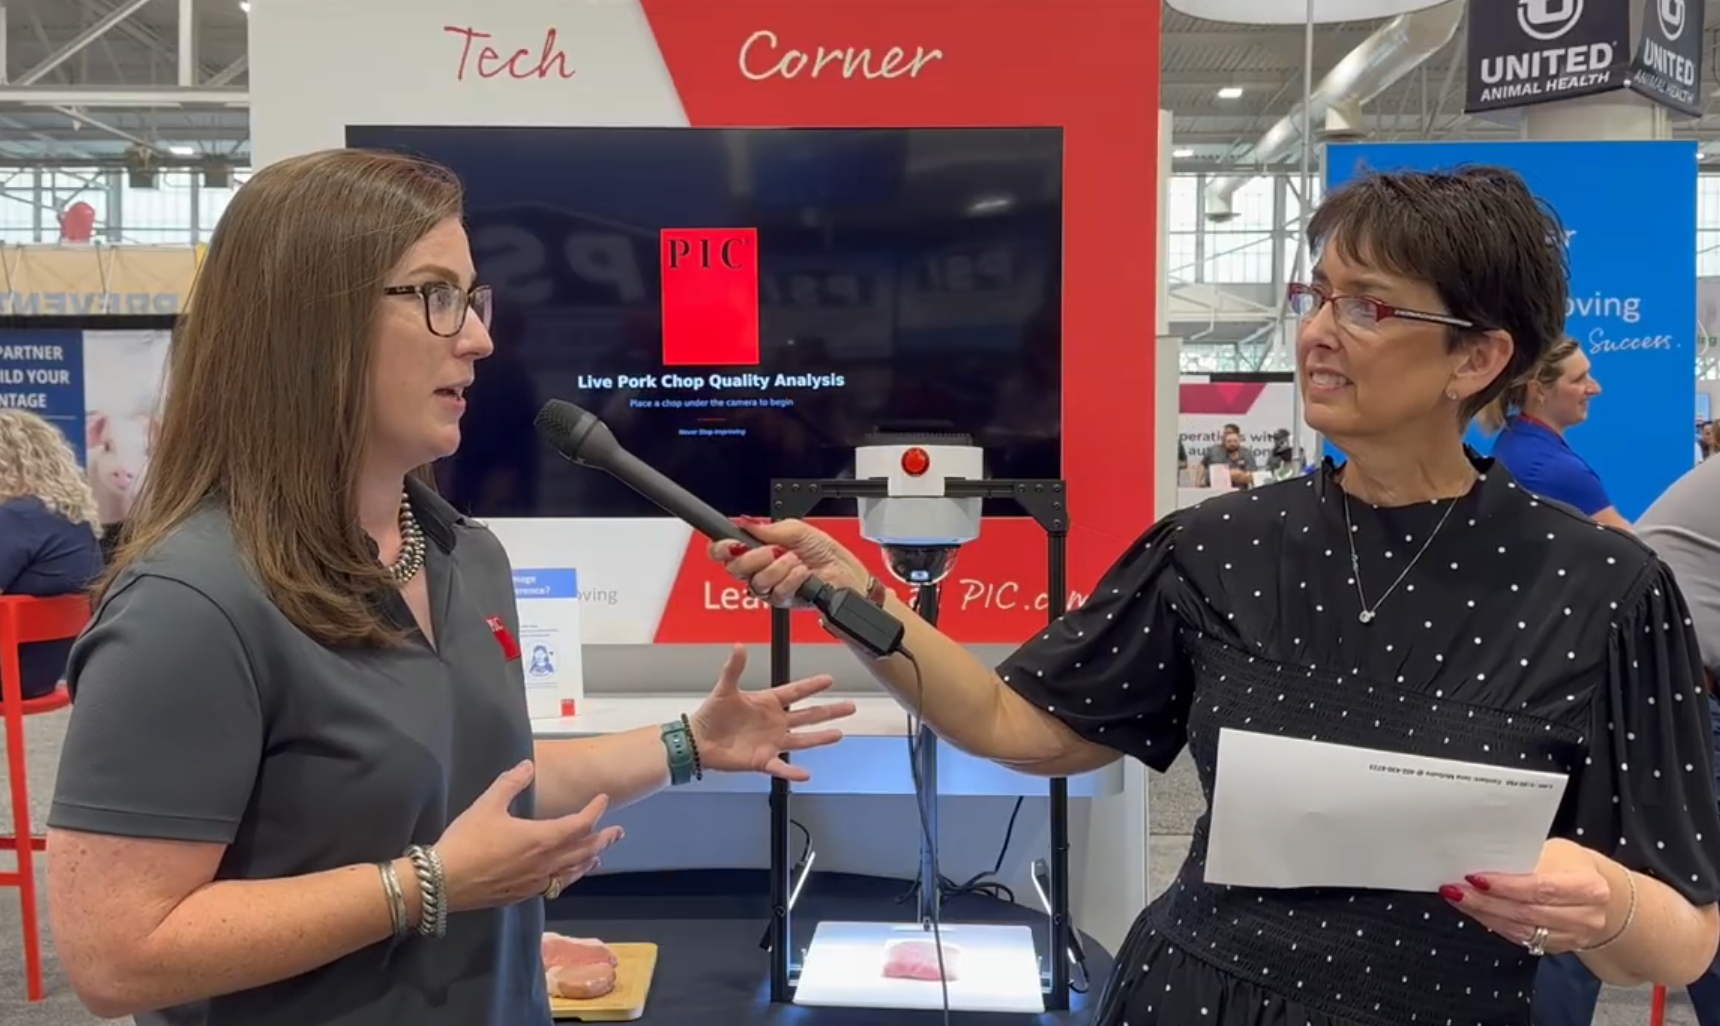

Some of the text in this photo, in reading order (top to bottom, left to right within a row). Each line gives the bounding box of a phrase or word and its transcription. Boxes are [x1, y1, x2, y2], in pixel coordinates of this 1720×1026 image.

[443, 25, 943, 82] Tech Corner
[1481, 42, 1613, 84] UNITED
[1643, 37, 1694, 87] UNITED
[1480, 71, 1610, 102] ANIMAL HEALTH
[1665, 82, 1695, 104] HEALTH
[668, 239, 743, 269] PIC
[0, 345, 63, 360] ARTNER
[1589, 327, 1681, 355] Success.
[26, 368, 71, 385] YOUR
[577, 372, 845, 391] Live Pork Chop Quality Analysis
[629, 399, 652, 408] Place
[661, 398, 682, 409] chop
[684, 398, 708, 408] under
[710, 398, 724, 407] the
[726, 399, 758, 407] camera
[759, 398, 768, 407] to
[770, 398, 794, 408] begin
